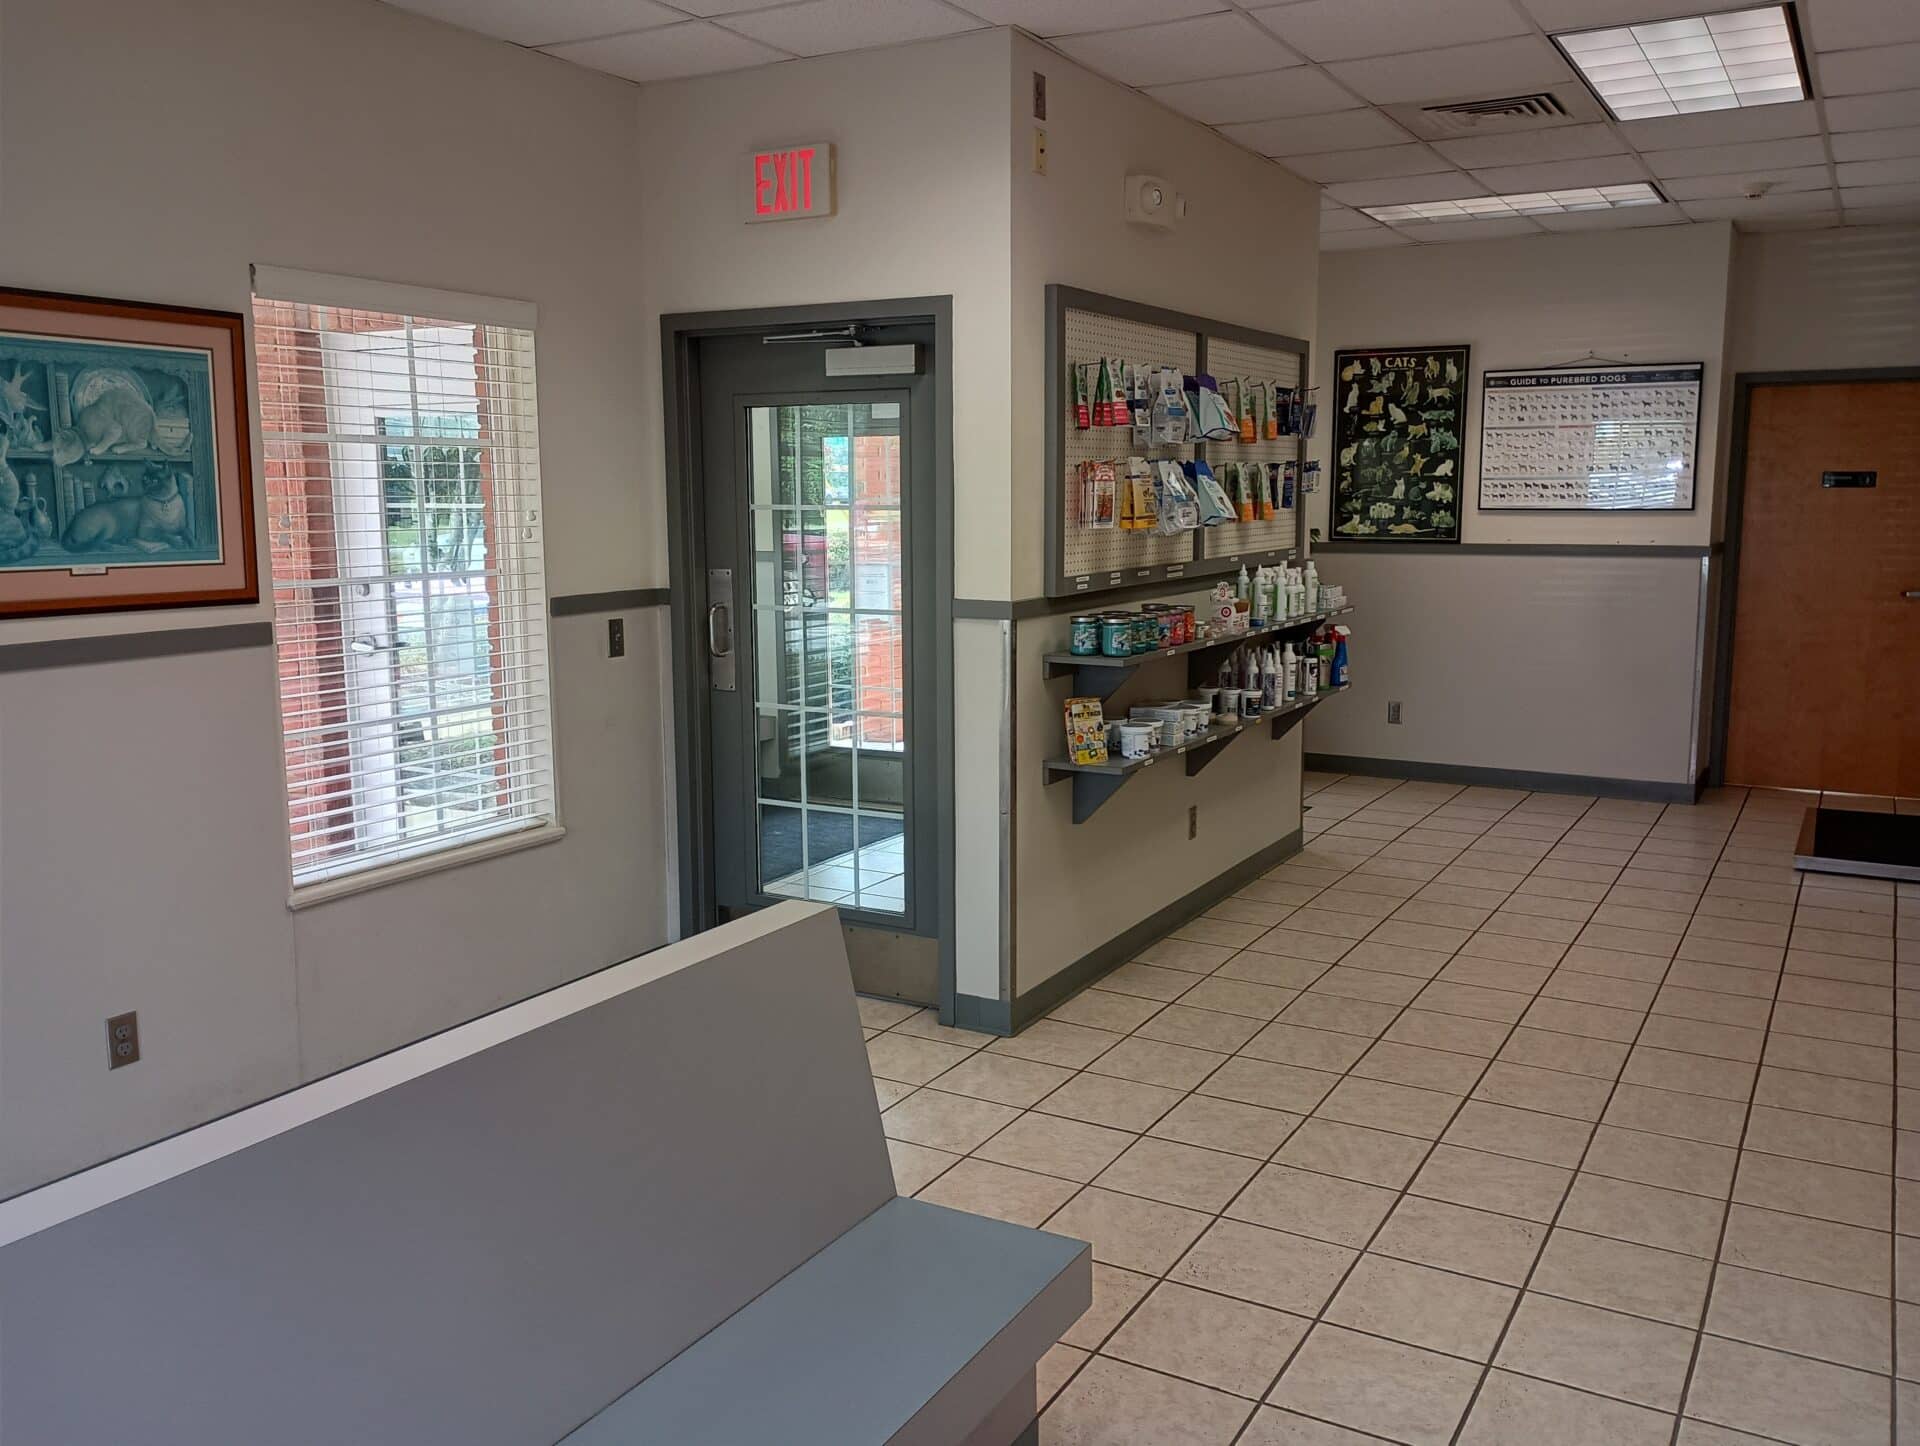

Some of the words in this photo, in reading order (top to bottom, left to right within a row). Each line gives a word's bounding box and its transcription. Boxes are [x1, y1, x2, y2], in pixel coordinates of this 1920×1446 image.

[755, 148, 815, 215] EXIT
[1385, 357, 1417, 368] CATS
[1510, 378, 1537, 386] GUIDE
[1550, 375, 1598, 385] PUREBRED
[1600, 374, 1627, 383] DOGS
